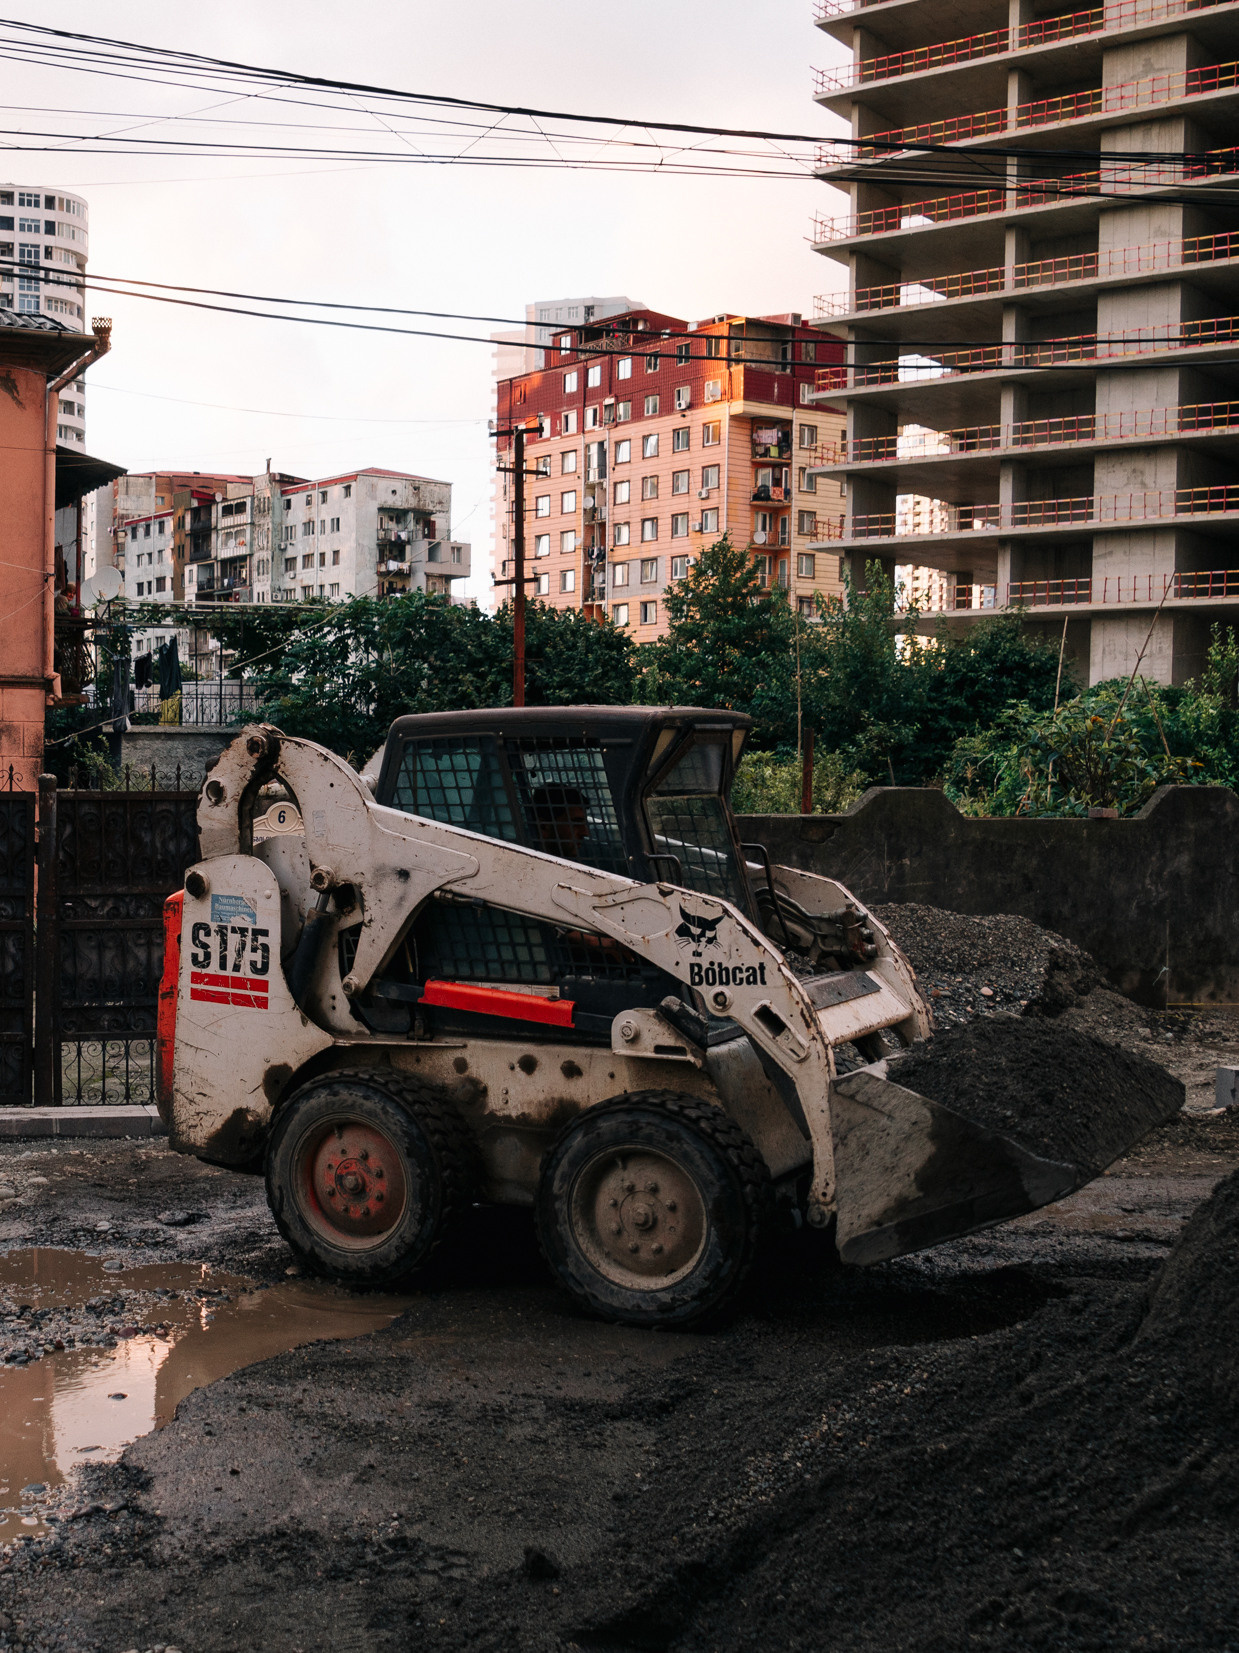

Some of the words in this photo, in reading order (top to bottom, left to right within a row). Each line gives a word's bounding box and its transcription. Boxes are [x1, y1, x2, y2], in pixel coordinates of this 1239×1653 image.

[277, 810, 286, 824] 6
[191, 922, 270, 976] S175
[689, 961, 767, 987] Bobcat
